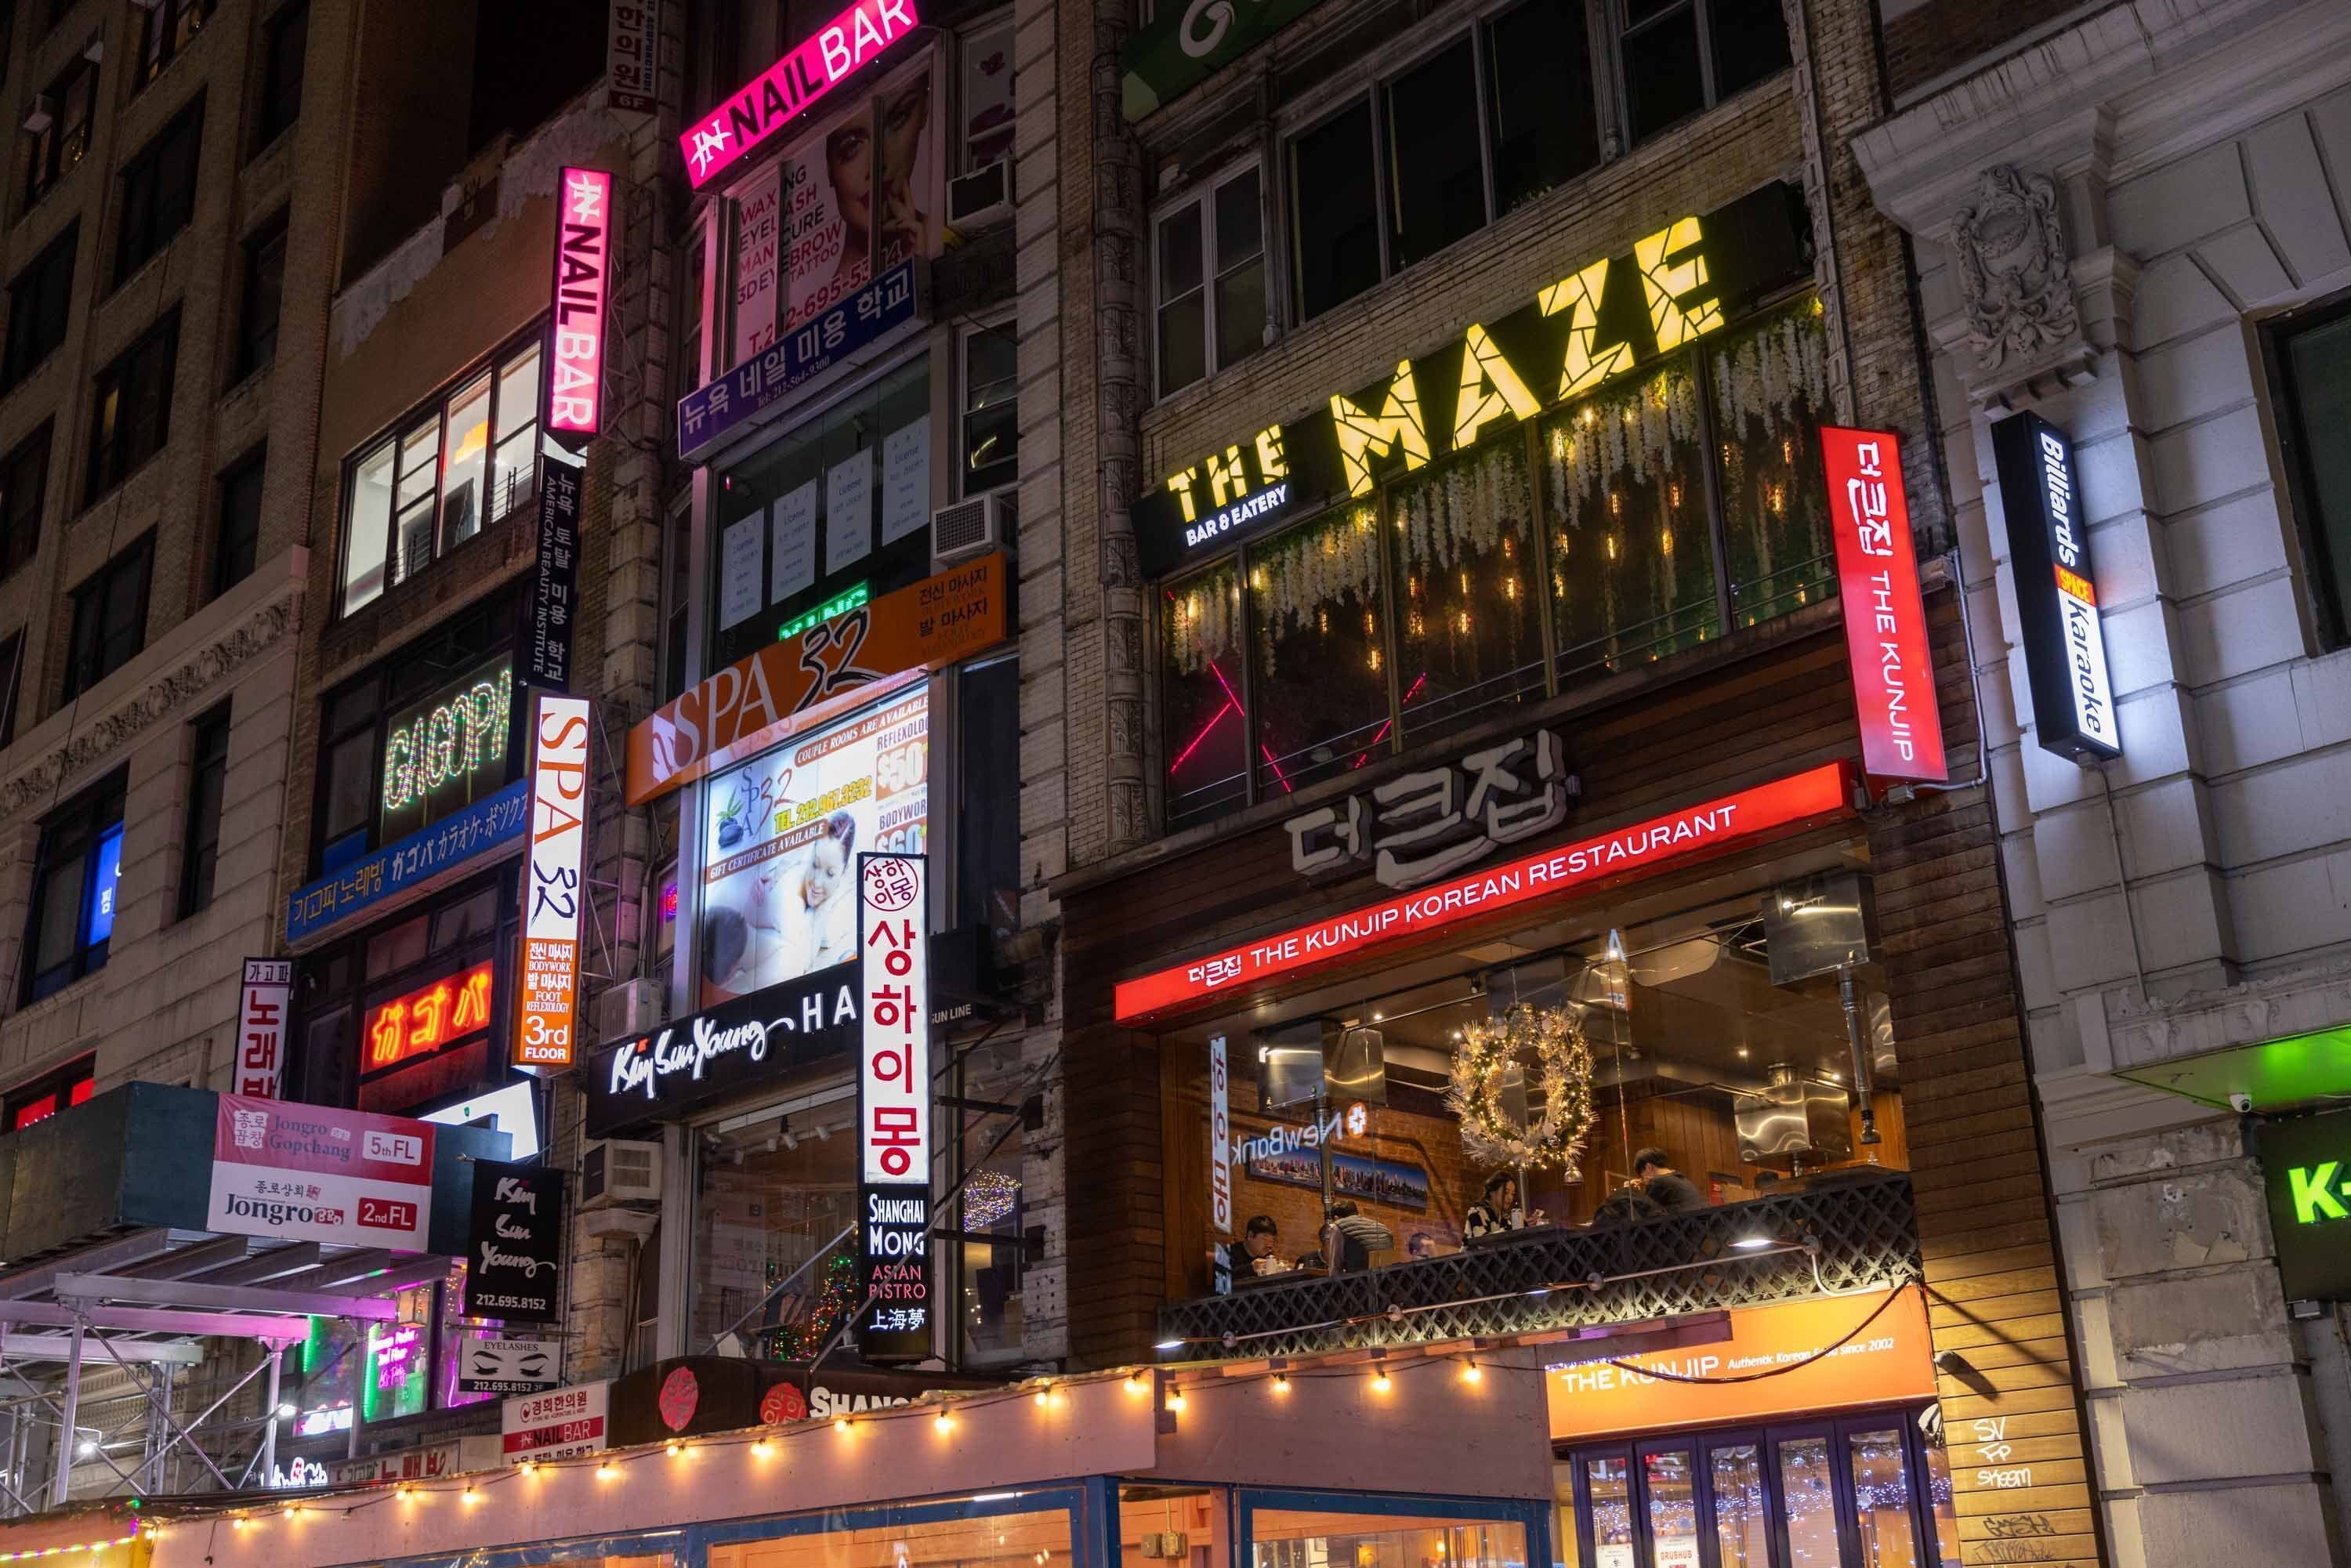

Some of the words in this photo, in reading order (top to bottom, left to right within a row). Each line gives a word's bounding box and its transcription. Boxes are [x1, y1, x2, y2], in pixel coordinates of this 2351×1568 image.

[728, 54, 824, 148] NAIL
[819, 0, 912, 81] BAR
[559, 223, 601, 325] NAIL
[789, 241, 840, 283] TATTOO
[685, 383, 729, 434] 뉴욕
[740, 346, 787, 400] 네일
[798, 310, 847, 362] 미용
[857, 268, 910, 320] 학교
[1330, 216, 1724, 498] MAZE
[551, 331, 596, 425] BAR
[1167, 424, 1290, 523] THE
[542, 476, 556, 548] AMERICAN
[1185, 519, 1218, 546] BAR
[1219, 513, 1230, 531] &
[1230, 484, 1287, 526] EATERY
[1847, 441, 1893, 556] 더큰집
[2041, 432, 2079, 567] Billiards
[538, 550, 552, 607] BEAUTY
[919, 581, 944, 606] 전신
[949, 566, 987, 592] 마사지
[2060, 569, 2090, 603] SPACE
[920, 617, 935, 637] 발
[941, 598, 987, 626] 마사지
[1871, 570, 1896, 634] THE
[534, 608, 547, 672] INSTITUTE
[674, 652, 781, 770] SPA
[790, 606, 884, 715] 32
[2067, 599, 2103, 734] Karaoke
[1880, 641, 1914, 762] KUNJIP
[797, 739, 828, 762] COUPLE
[830, 728, 859, 751] ROOMS
[861, 718, 878, 737] ARE
[878, 693, 928, 729] AVAILABLE
[534, 712, 588, 846] SPA
[877, 743, 924, 792] $50
[755, 768, 798, 835] 32
[796, 775, 873, 825] 212.967.3232
[1283, 729, 1569, 891] 더큰집
[710, 864, 727, 880] GIFT
[728, 842, 777, 872] CERTIFICATE
[777, 824, 825, 853] AVAILABLE
[531, 859, 578, 931] 32
[1188, 954, 1241, 987] 더큰집
[1251, 938, 1299, 968] THE
[1306, 908, 1399, 953] KUNJIP
[1405, 871, 1521, 922] KOREAN
[1529, 805, 1737, 885] RESTAURANT
[249, 964, 288, 981] 가고파
[529, 961, 571, 972] BODYWORK
[530, 942, 546, 960] 전신
[549, 943, 573, 961] 마사지
[527, 972, 539, 990] 발
[541, 973, 571, 991] 마사지
[535, 990, 562, 1002] FOOT
[526, 1001, 570, 1013] REFLEXOLOGY
[950, 1003, 972, 1021] LINE
[525, 1015, 568, 1045] 3rd
[868, 919, 921, 1175] 상하이몽
[525, 1047, 567, 1059] FLOOR
[609, 1037, 657, 1099] Kim
[654, 1029, 694, 1074] Sun
[693, 1017, 794, 1079] Young
[270, 1115, 327, 1136] Jongro
[371, 1137, 391, 1157] 5th
[394, 1140, 415, 1160] FL
[270, 1135, 351, 1161] Gopchang
[226, 1193, 313, 1226] Jongro
[364, 1203, 386, 1223] 2nd
[389, 1206, 411, 1226] FL
[255, 1180, 304, 1198] 종로상회
[494, 1177, 536, 1215] Kim
[869, 1193, 925, 1223] SHANGHAI
[495, 1214, 532, 1240] Sun
[869, 1226, 925, 1255] MONG
[480, 1241, 557, 1279] Young
[872, 1265, 922, 1280] ASIAN
[476, 1294, 546, 1310] 212.695.8152
[869, 1308, 926, 1331] 上海夢
[484, 1341, 539, 1352] EYELASHES
[1561, 1368, 1615, 1393] THE
[1620, 1355, 1720, 1389] KUNJIP
[1727, 1353, 1774, 1370] Authentic
[1777, 1351, 1811, 1363] Korean
[1840, 1343, 1867, 1355] since
[1868, 1338, 1894, 1351] 2002
[473, 1381, 531, 1392] 212.695.8152
[533, 1391, 587, 1415] 경희한의원
[534, 1425, 563, 1447] NAIL
[564, 1421, 591, 1442] BAR
